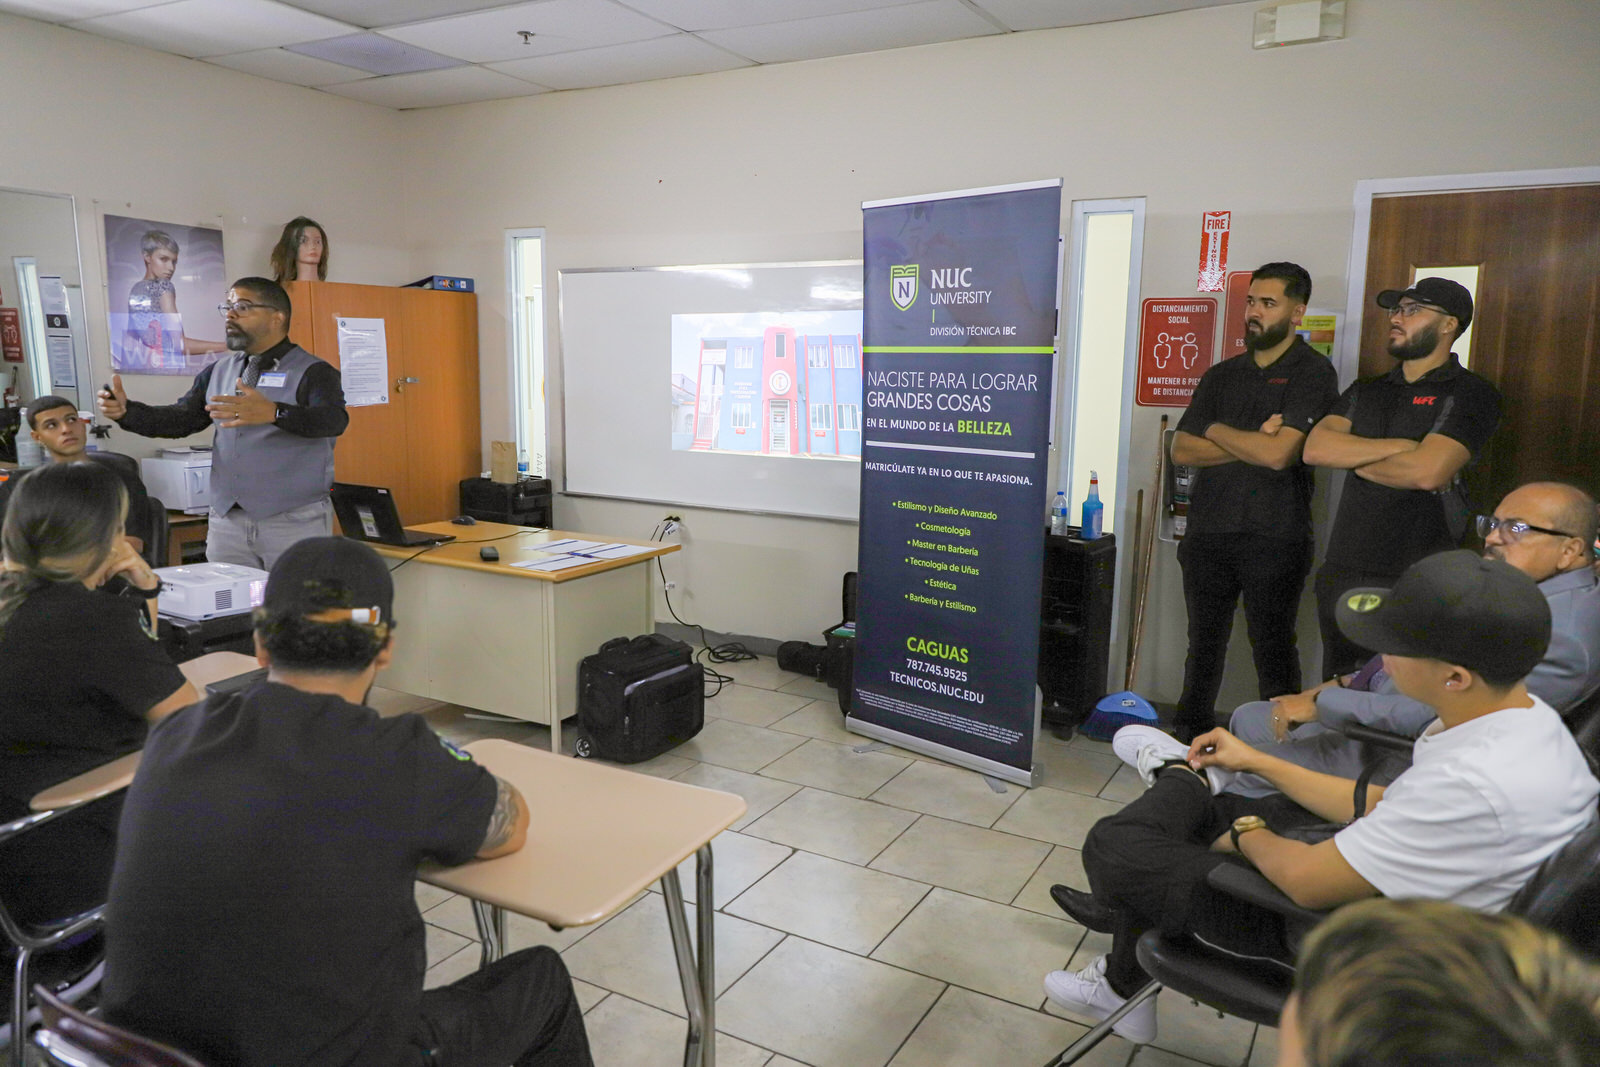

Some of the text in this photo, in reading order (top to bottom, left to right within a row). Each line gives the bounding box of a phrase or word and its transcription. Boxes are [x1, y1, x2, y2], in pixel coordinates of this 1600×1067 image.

[1206, 218, 1226, 230] FIRE
[931, 267, 972, 289] NUC
[930, 291, 992, 305] UNIVERSITY
[1152, 304, 1209, 313] DISTANCIAMIENTO
[1168, 316, 1190, 324] SOCIAL
[930, 325, 1016, 336] DIVISIÓN TÉCNICA IBC
[867, 371, 1038, 391] NACISTE PARA LOGRAR
[1147, 376, 1181, 385] MANTENER
[1153, 387, 1162, 396] DE
[867, 391, 991, 413] GRANDES COSAS
[866, 418, 1012, 436] EN EL MUNDO DE LA BELLEZA
[865, 462, 1033, 486] MATRICÚLATE YA EN LO QUE TE APASIONA.
[897, 500, 998, 520] Estilismo y Diseño Avanzado
[912, 539, 936, 550] Master
[937, 544, 946, 552] en
[949, 563, 960, 573] de
[961, 565, 980, 576] Uñas
[929, 578, 957, 591] Estética
[939, 600, 944, 608] y
[945, 600, 977, 613] Estilismo
[906, 636, 969, 664] CAGUAS
[906, 658, 968, 682] 787.745.9525
[890, 671, 984, 704] TECNICOS.NUC.EDU
